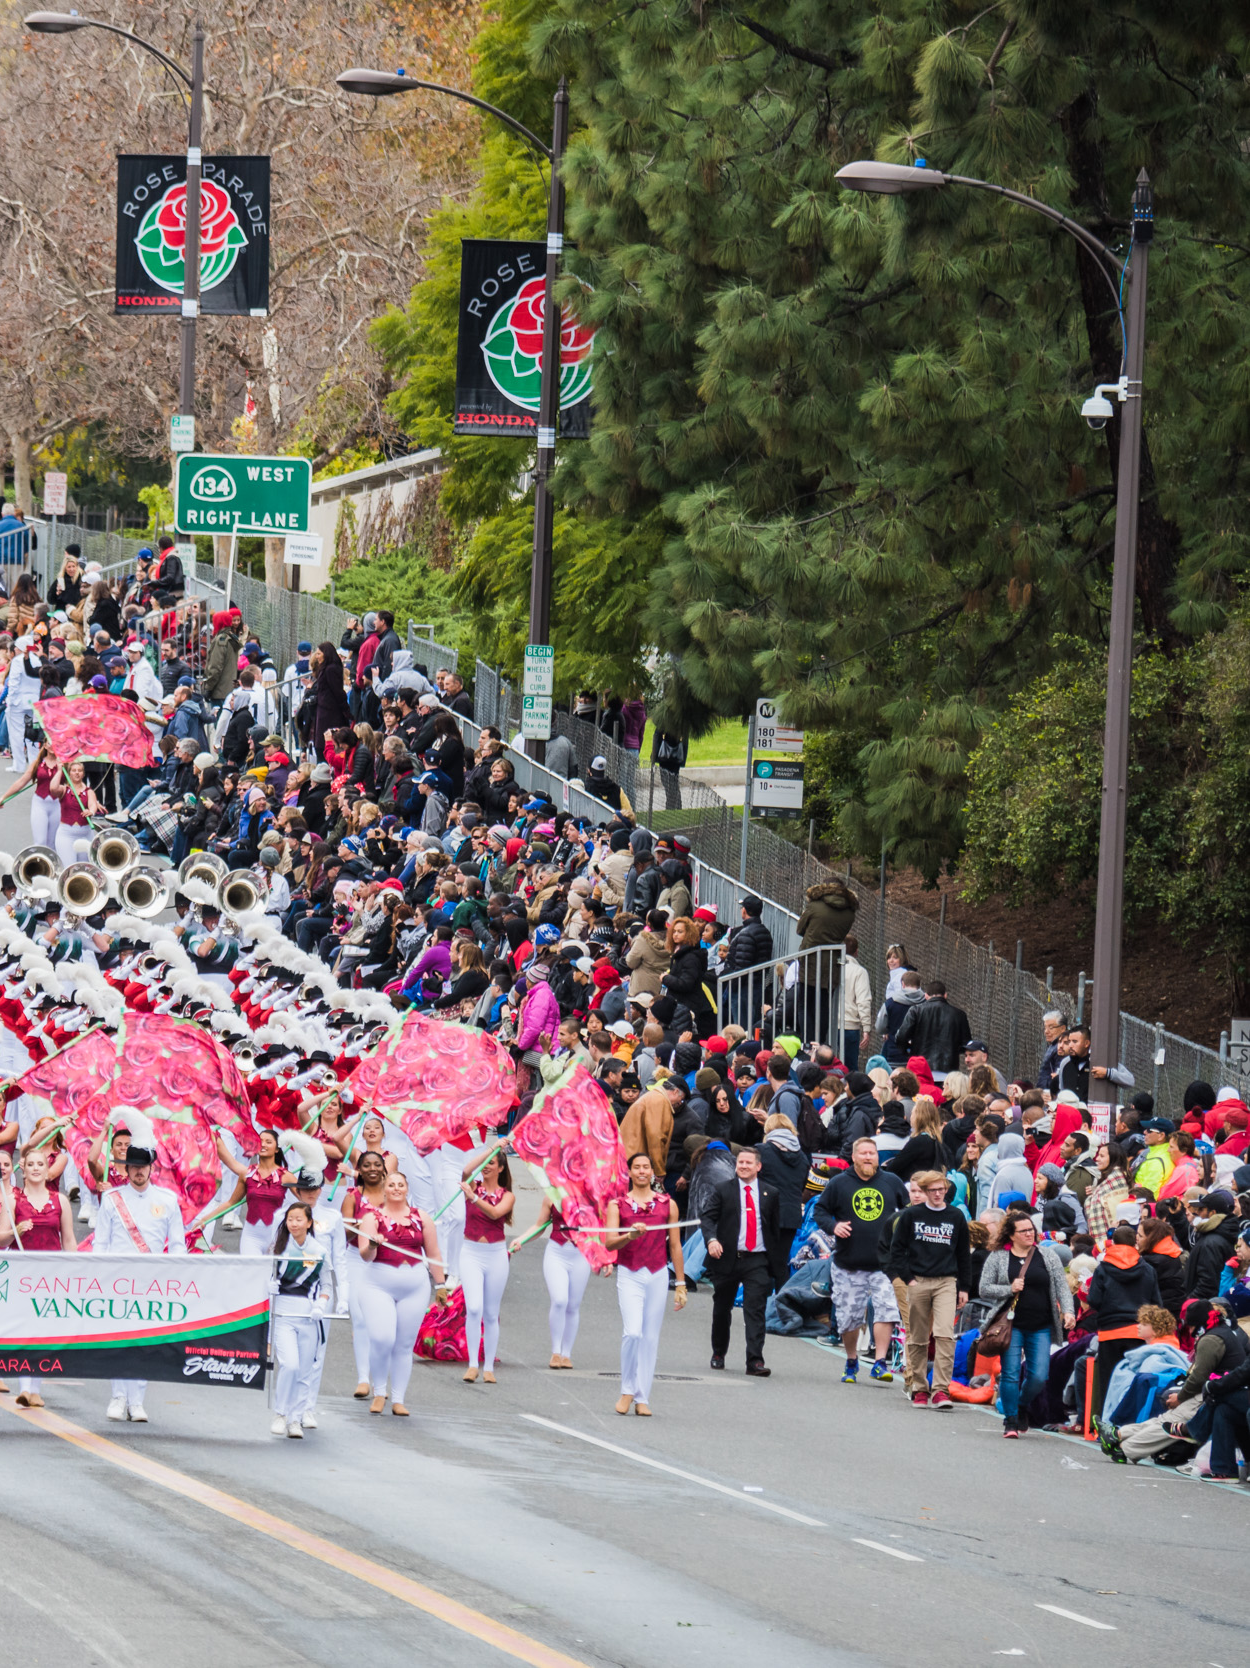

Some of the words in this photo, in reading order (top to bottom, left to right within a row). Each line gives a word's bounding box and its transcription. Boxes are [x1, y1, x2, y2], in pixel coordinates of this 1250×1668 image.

[123, 165, 178, 218] ROSE
[203, 163, 267, 237] PARADE
[467, 253, 535, 318] ROSE
[117, 296, 182, 306] HONDA
[173, 418, 180, 426] 2
[456, 413, 537, 427] HONDA
[247, 466, 294, 482] WEST
[198, 477, 230, 496] 134
[187, 510, 242, 526] RIGHT
[251, 512, 299, 528] LANE
[290, 544, 318, 552] PEDESTRIAN
[527, 647, 552, 656] BEGIN
[531, 657, 547, 665] TURN
[527, 666, 551, 674] WHEELS
[526, 698, 533, 708] 2
[525, 712, 549, 720] PARKING
[758, 728, 775, 737] 180
[757, 739, 773, 748] 181
[760, 782, 768, 791] 10
[914, 1221, 953, 1238] Kanye
[923, 1235, 951, 1246] President
[18, 1276, 103, 1294] SANTA
[112, 1278, 201, 1298] CLARA
[30, 1298, 188, 1322] VANGUARD
[185, 1346, 209, 1355] Official
[210, 1348, 235, 1357] Uniform
[236, 1350, 260, 1359] Partner
[38, 1359, 63, 1372] CA
[182, 1356, 261, 1383] Stanbury
